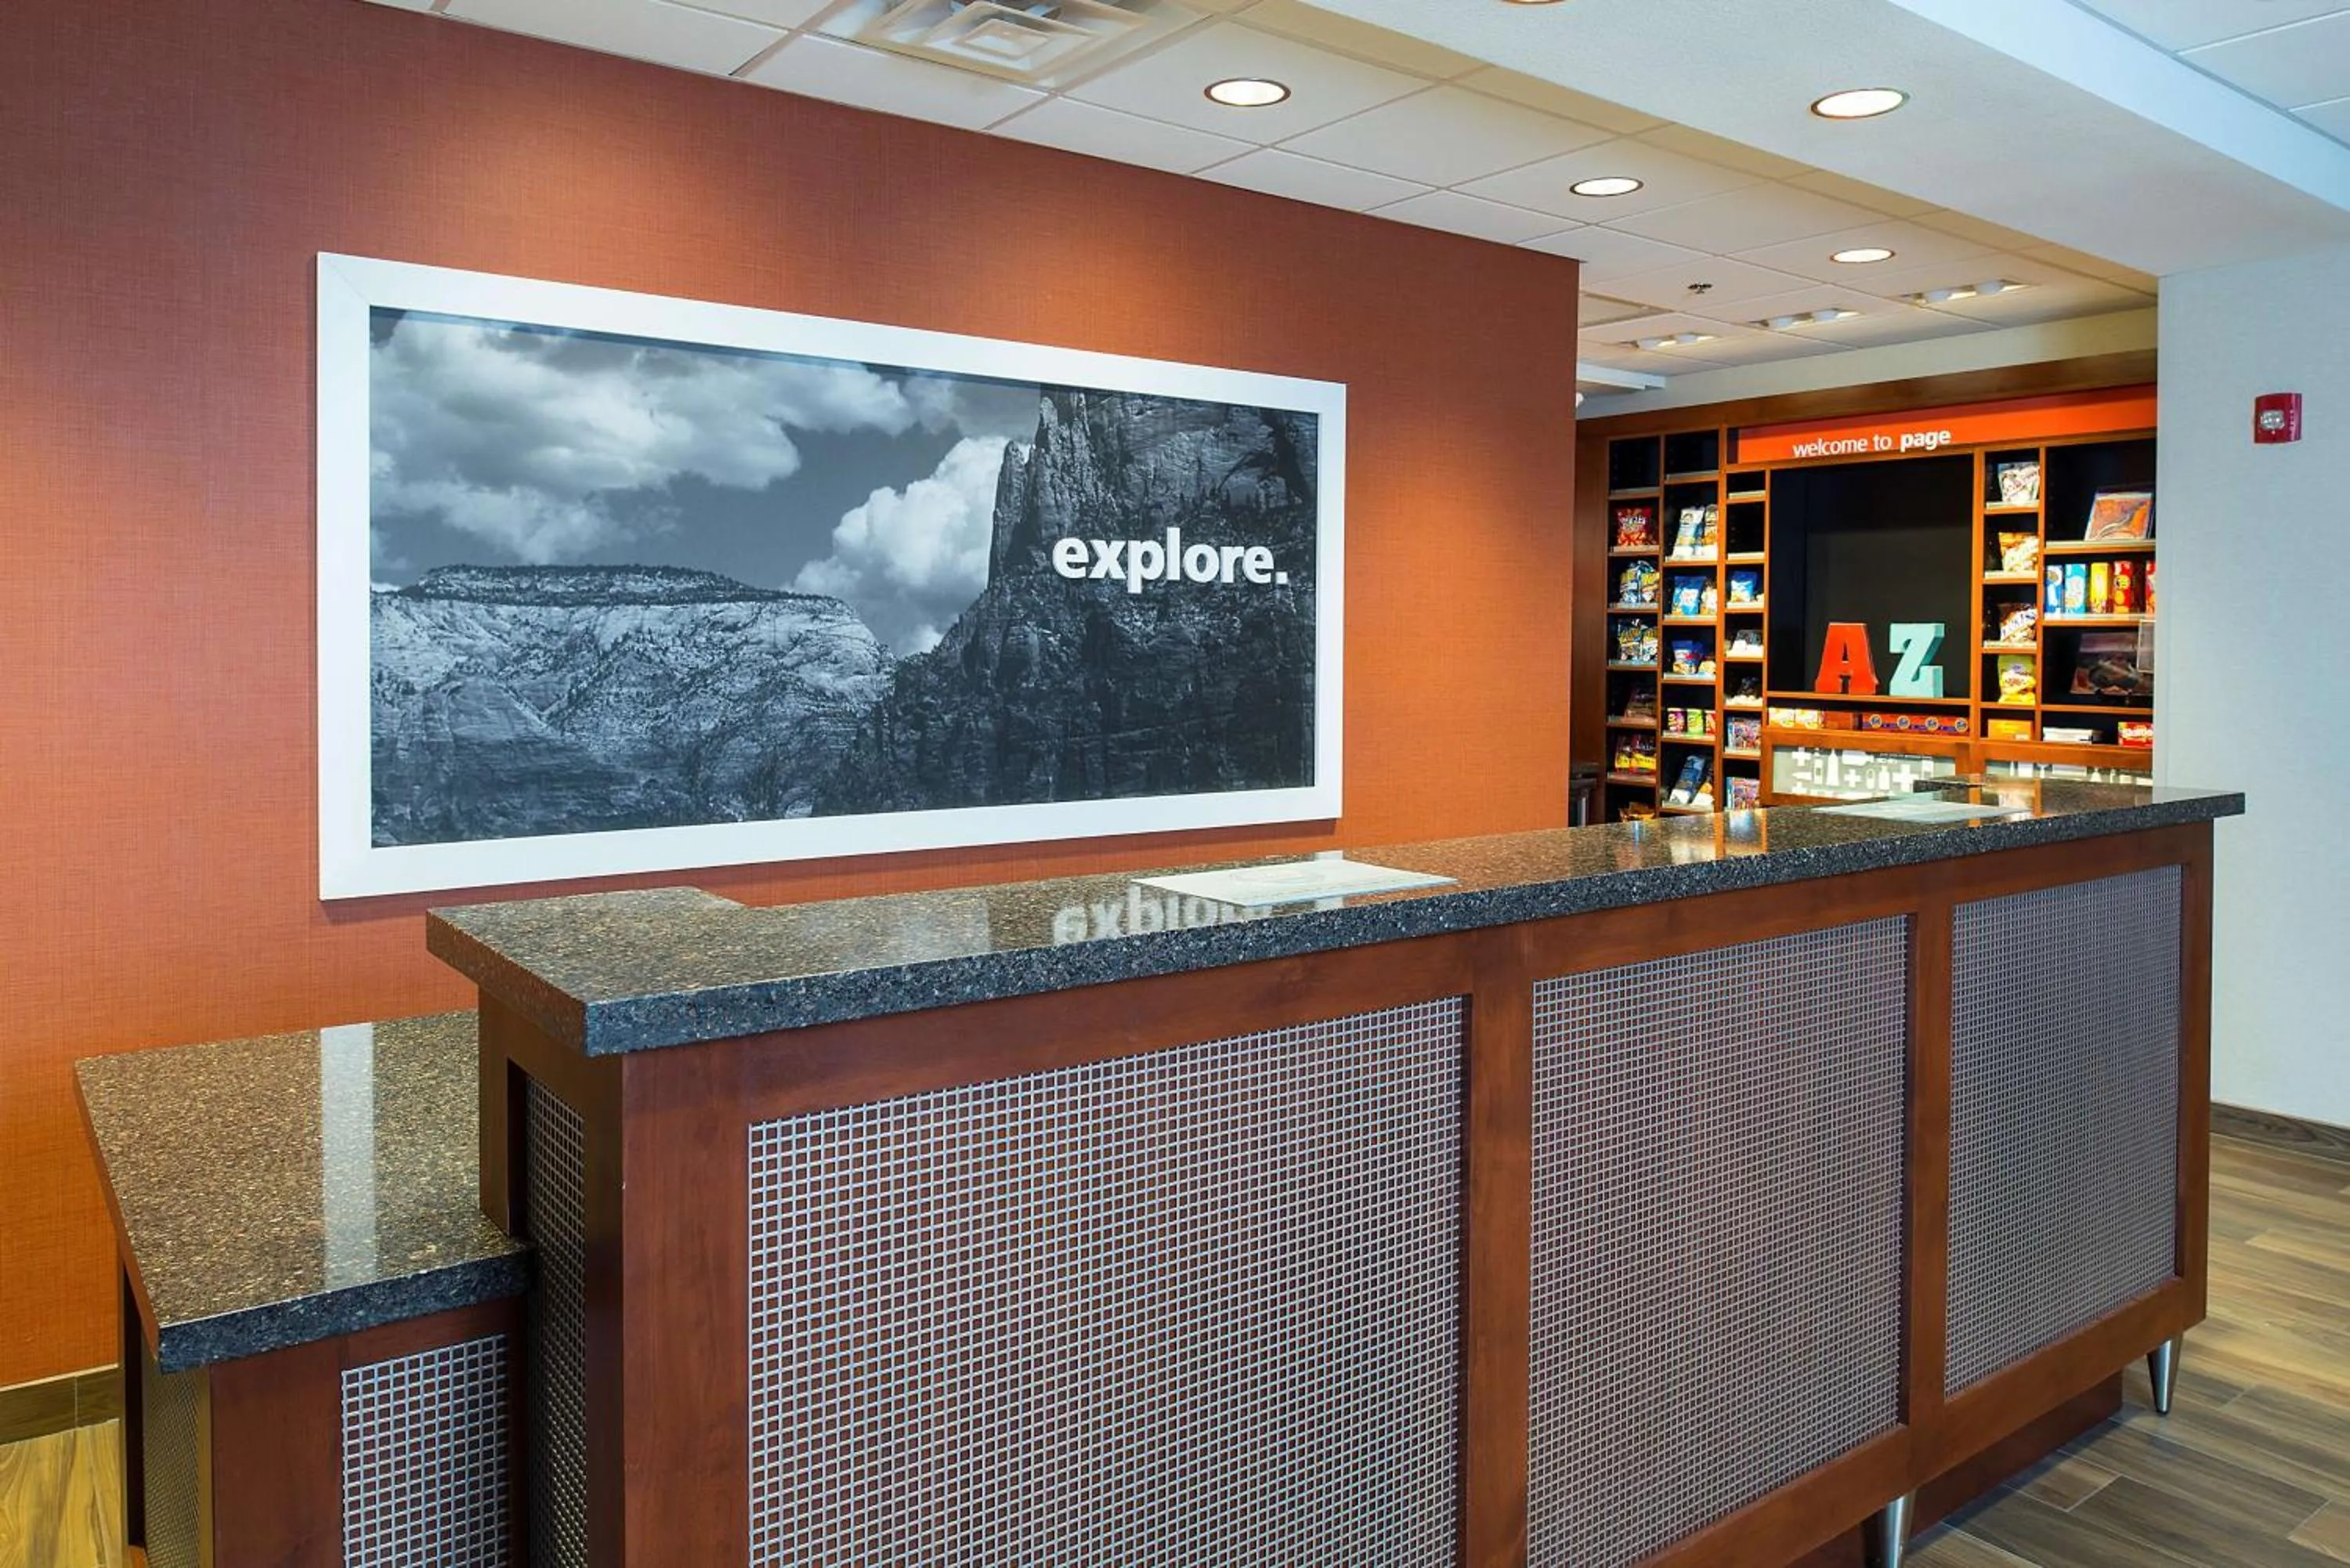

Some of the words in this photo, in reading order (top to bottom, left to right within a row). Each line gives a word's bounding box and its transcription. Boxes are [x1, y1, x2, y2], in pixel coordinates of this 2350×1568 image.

[1791, 438, 1868, 458] welcome
[1872, 434, 1893, 452] to
[1900, 429, 1951, 453] page
[1052, 526, 1289, 594] explore.
